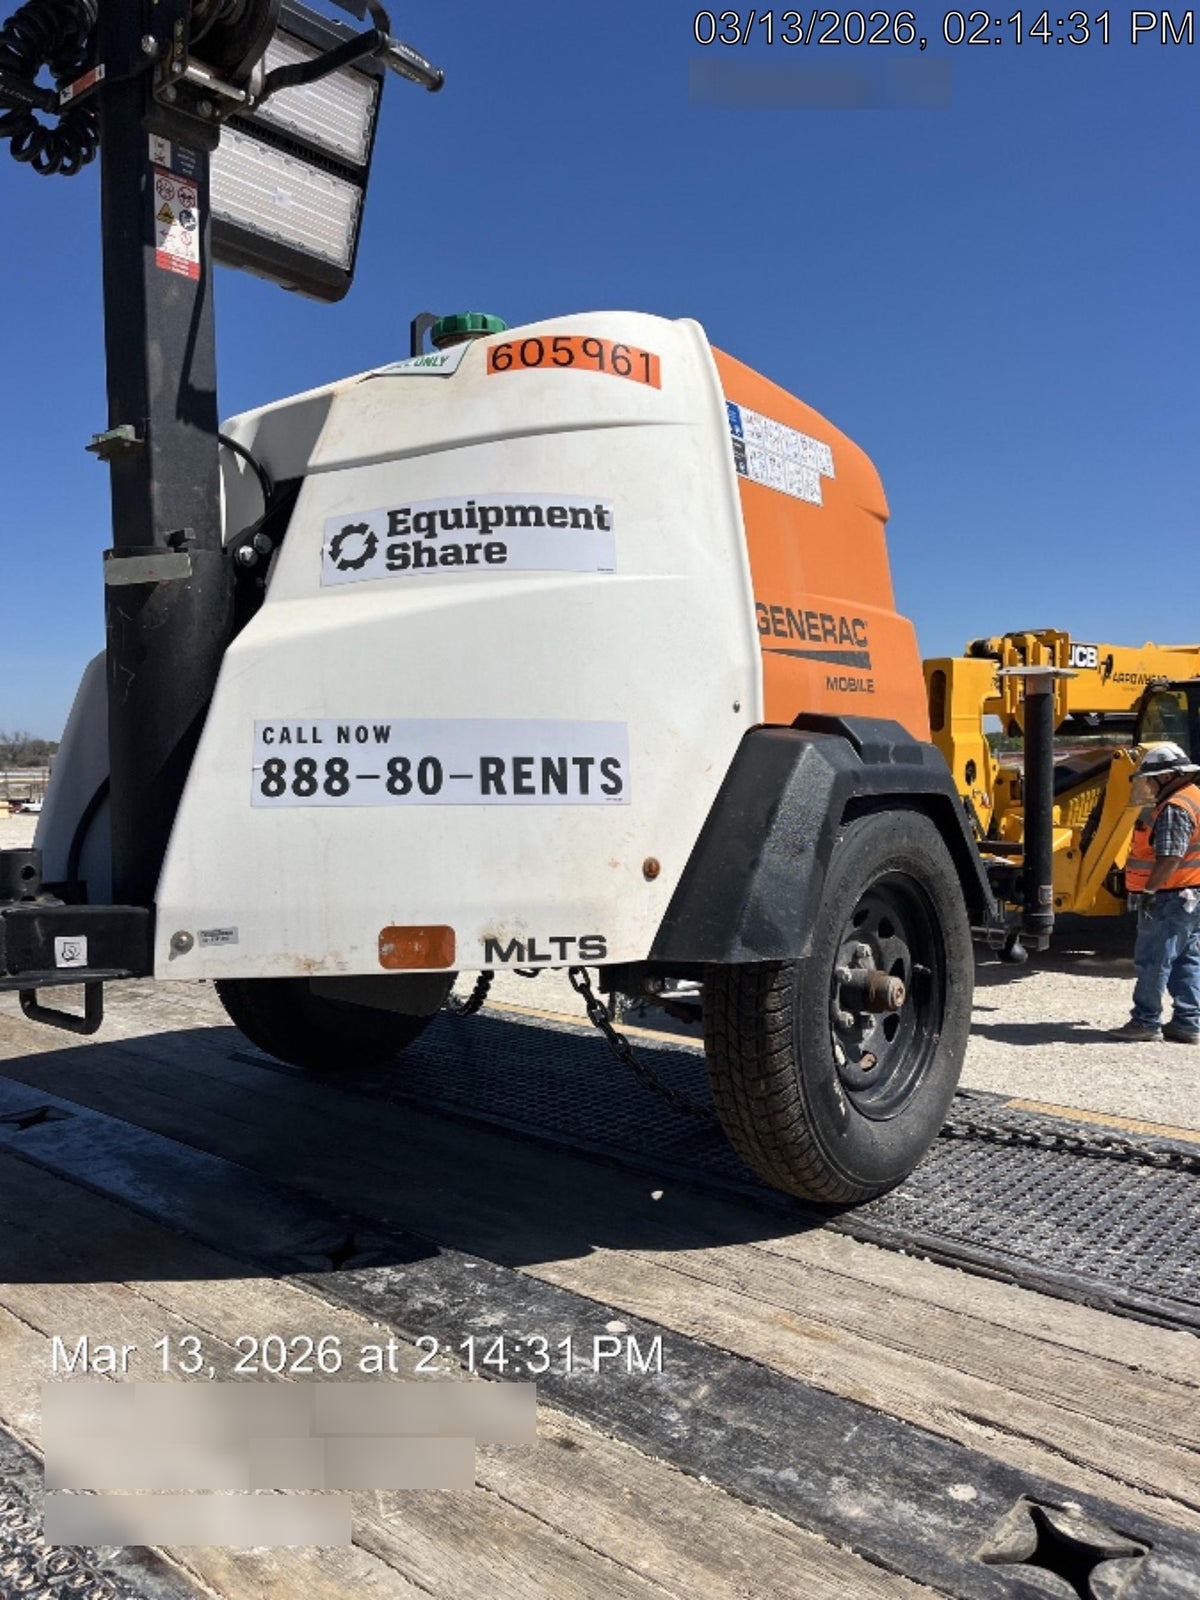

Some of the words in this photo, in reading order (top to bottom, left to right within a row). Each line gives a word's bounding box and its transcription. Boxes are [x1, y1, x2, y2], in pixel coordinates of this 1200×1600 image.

[413, 355, 450, 367] ONLY
[491, 336, 651, 383] 605961
[386, 501, 611, 540] Equipment
[385, 540, 508, 571] Share
[755, 602, 868, 648] GENERAC
[1068, 644, 1098, 668] JCB
[826, 676, 875, 694] MOBILE
[262, 725, 323, 744] CALL
[337, 725, 392, 744] NOW
[260, 756, 623, 797] 888-80-RENTS
[485, 934, 607, 964] MLTS
